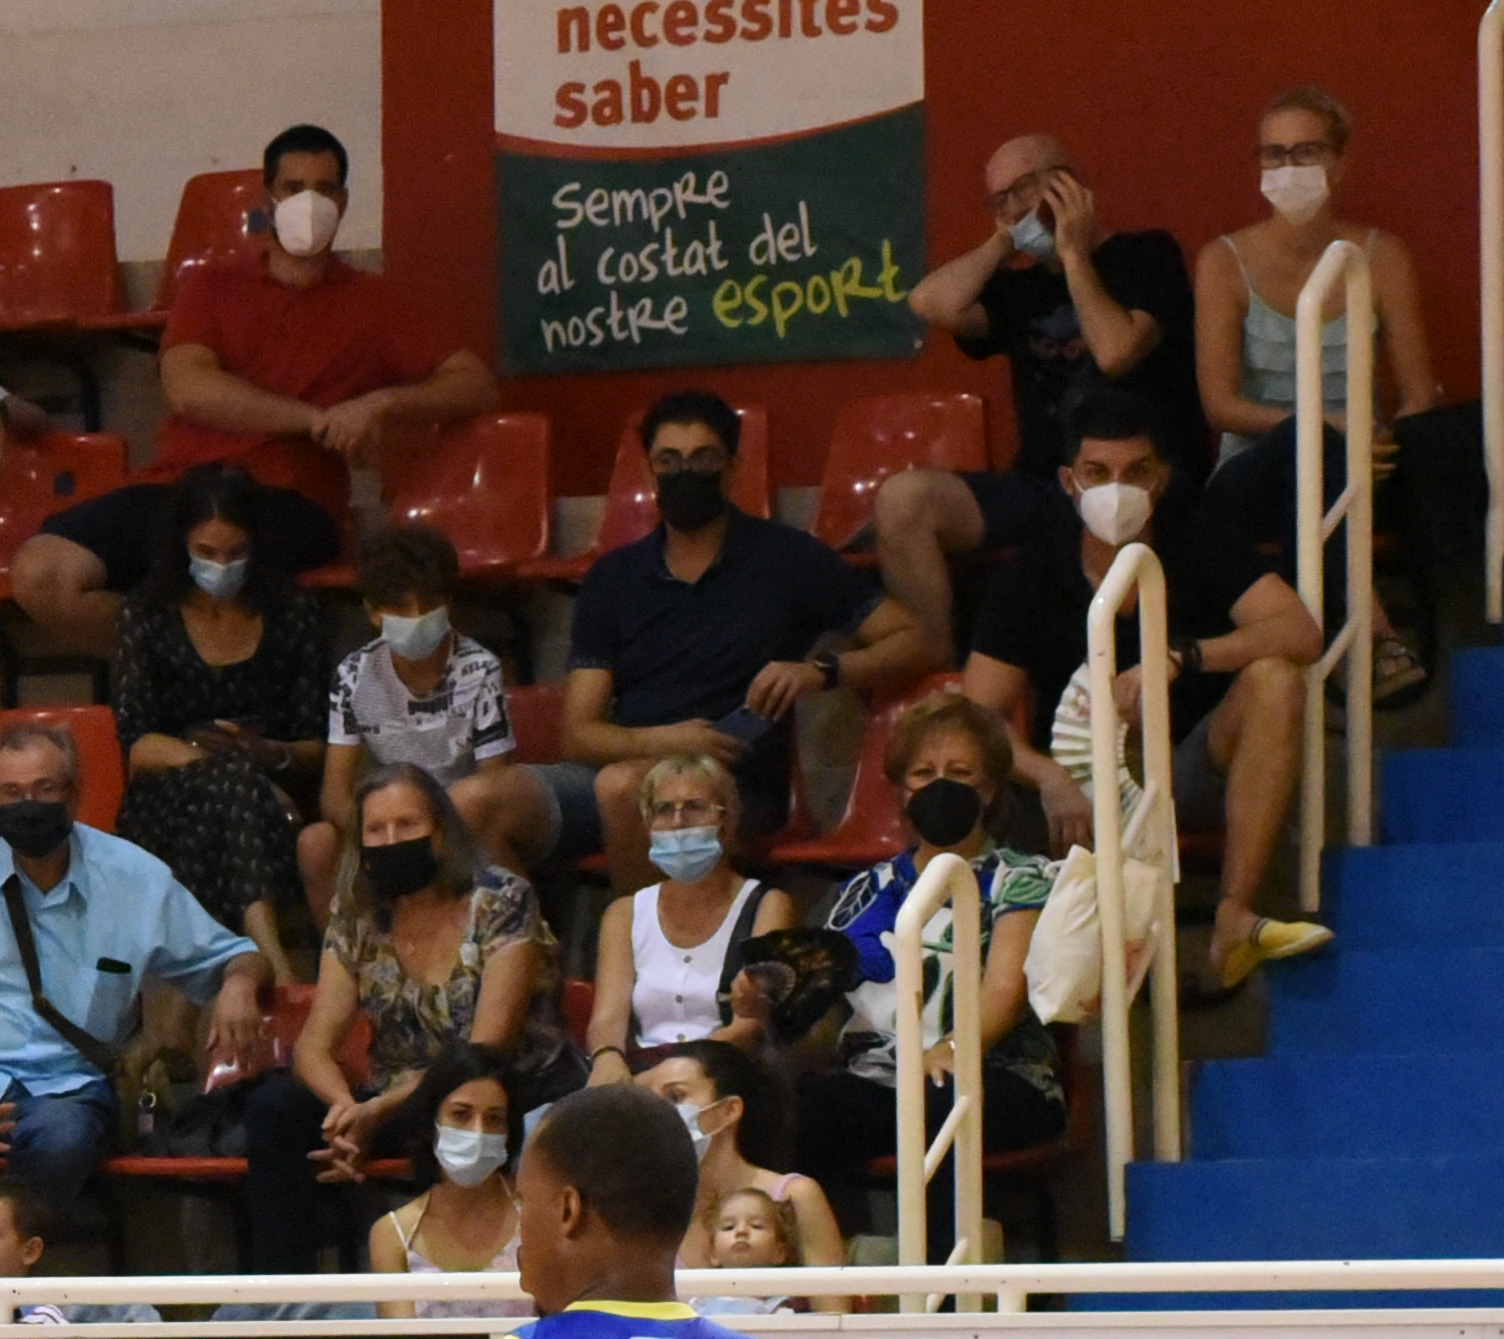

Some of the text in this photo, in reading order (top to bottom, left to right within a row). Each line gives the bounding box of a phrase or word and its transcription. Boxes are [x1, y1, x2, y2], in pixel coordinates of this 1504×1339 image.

[553, 60, 730, 128] saber
[537, 201, 817, 295] al costat del
[540, 294, 689, 352] nostre
